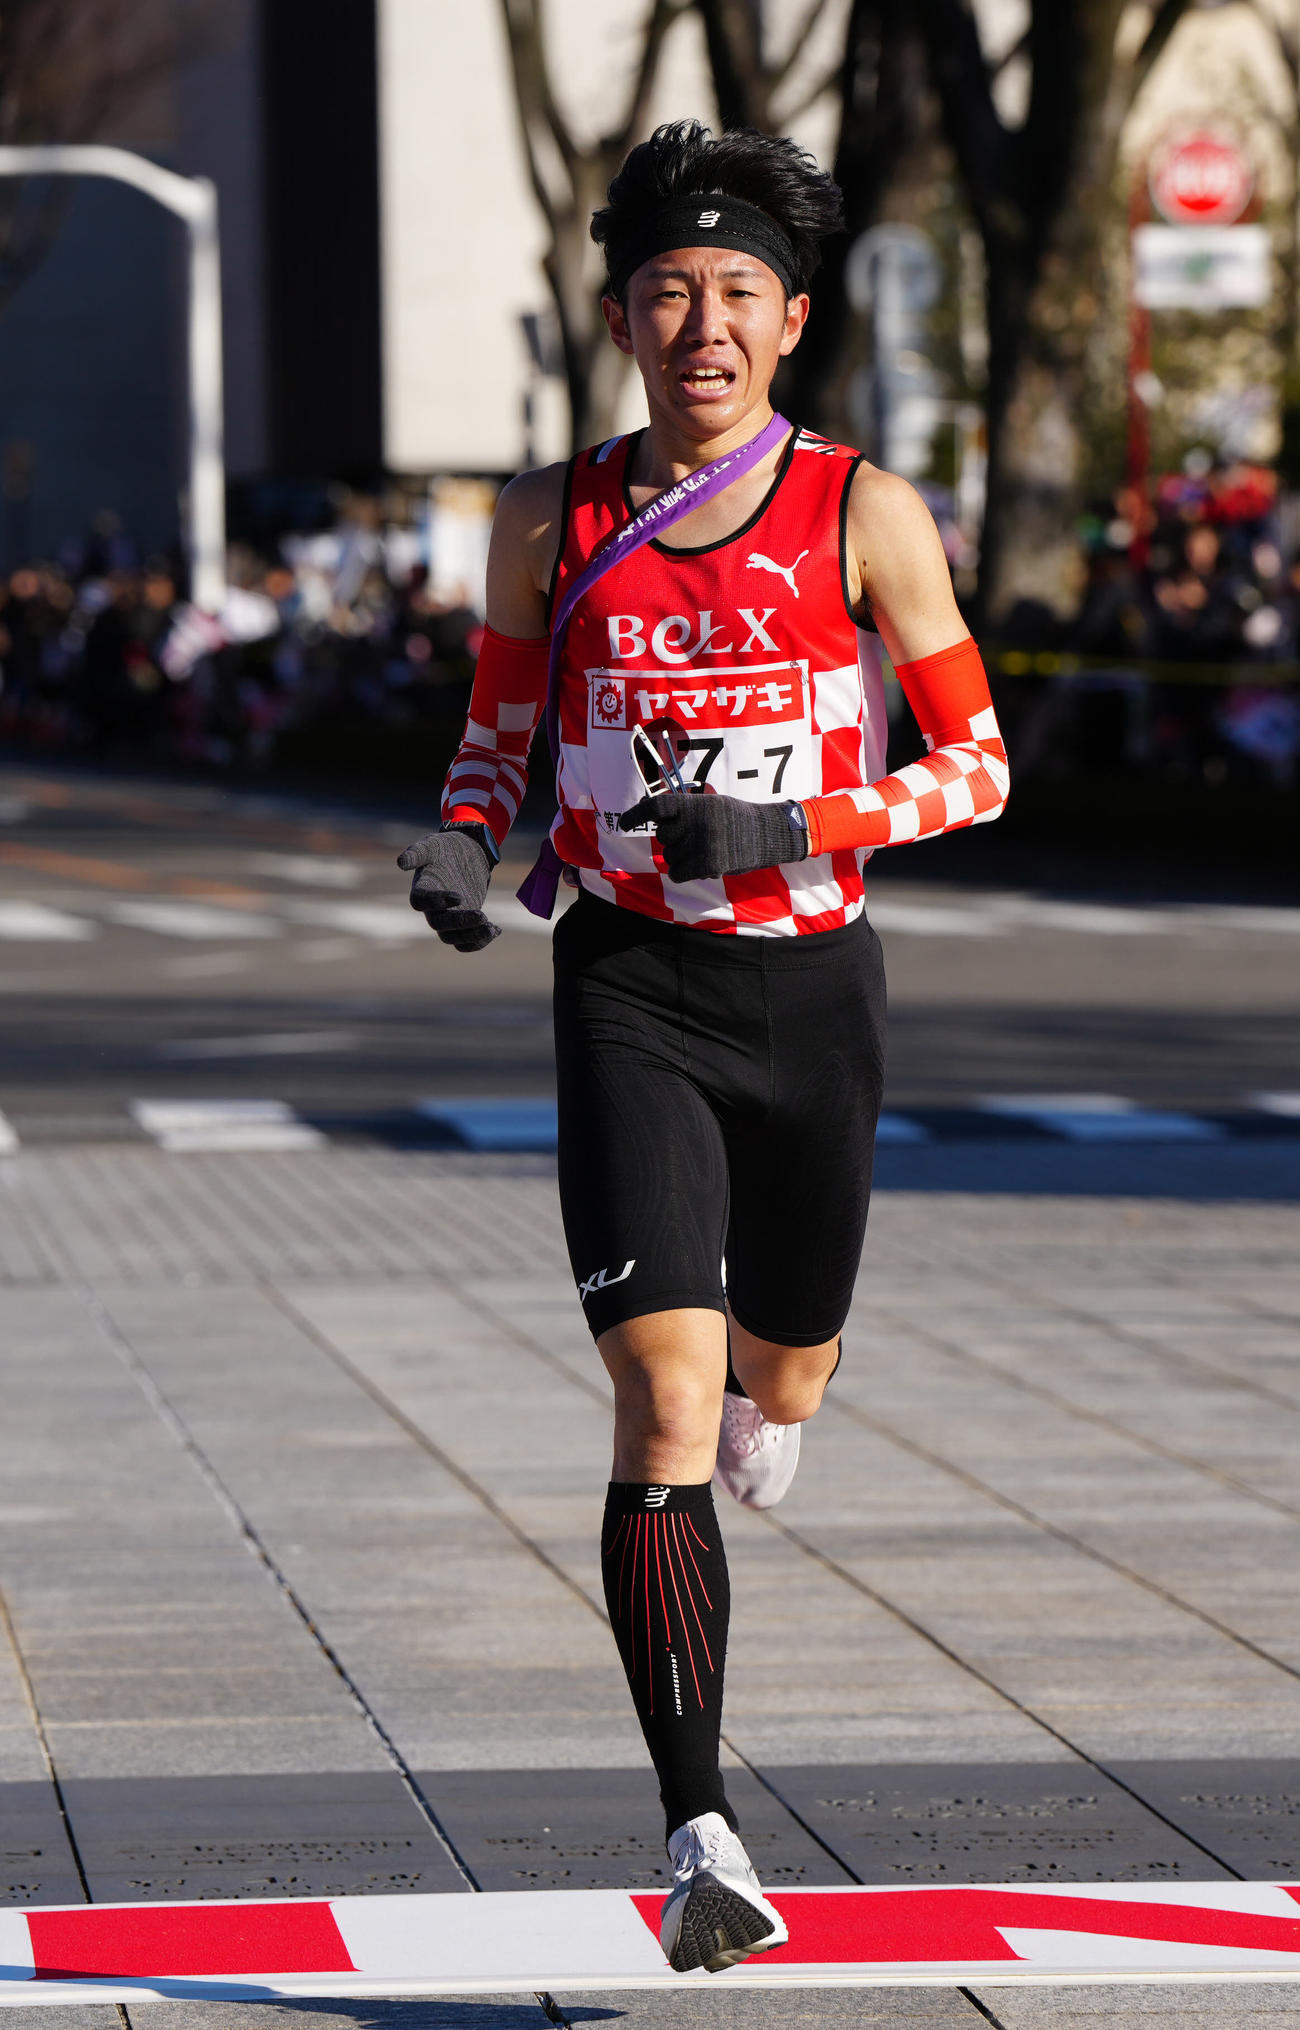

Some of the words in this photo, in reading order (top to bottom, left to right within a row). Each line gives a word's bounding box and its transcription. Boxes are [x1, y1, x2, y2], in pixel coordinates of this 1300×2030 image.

[633, 682, 793, 719] ヤマザキ
[670, 1653, 683, 1716] COMPRESSPORT
